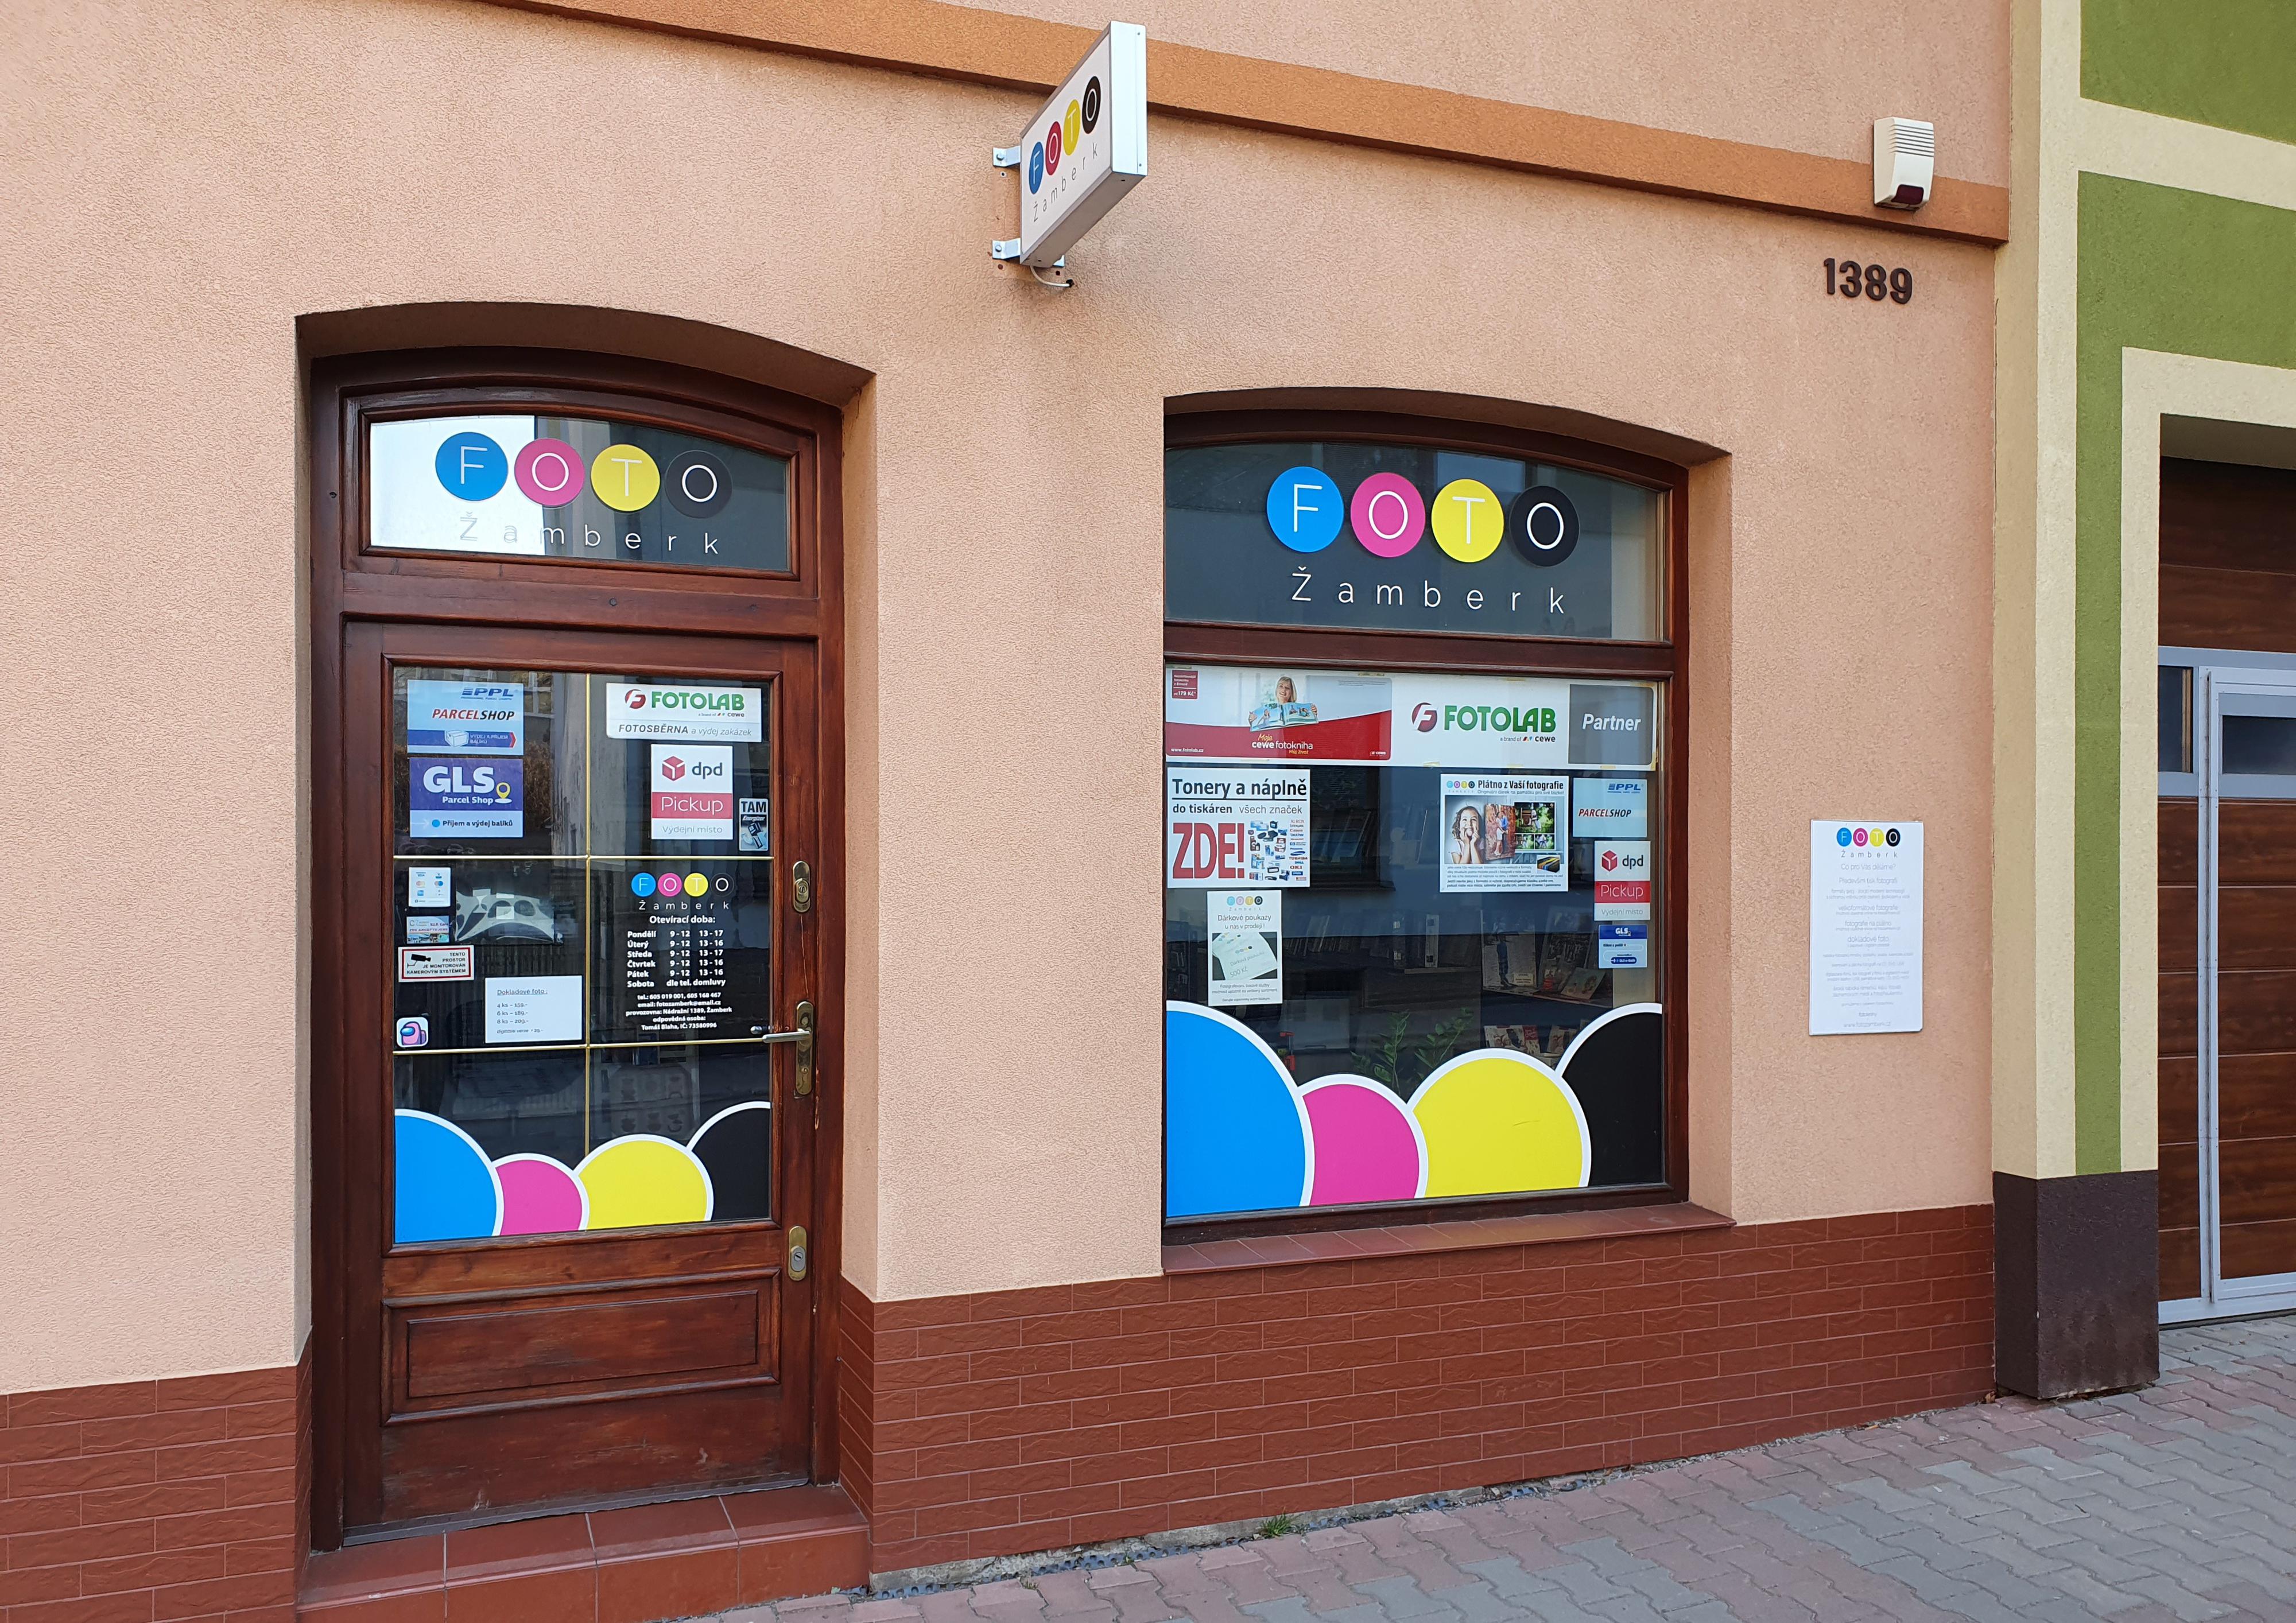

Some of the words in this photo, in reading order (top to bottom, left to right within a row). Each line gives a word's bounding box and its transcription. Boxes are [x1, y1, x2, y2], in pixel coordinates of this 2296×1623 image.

[1032, 87, 1098, 186] FOTO
[1033, 143, 1098, 223] Žamberk
[1824, 258, 1913, 305] 1389
[459, 444, 719, 504] FOTO
[1289, 480, 1568, 553] FOTO
[460, 511, 719, 555] Žamberk
[1292, 566, 1564, 614] Žamberk
[474, 688, 514, 697] PPL
[651, 690, 745, 710] FOTOLAB
[432, 708, 515, 721] PARCELSHOP
[1444, 705, 1556, 733] FOTOLAB
[1582, 713, 1641, 731] Partner
[619, 724, 689, 734] FOTOSBĚRNA
[697, 727, 719, 737] výdej
[720, 726, 752, 736] zakázek
[1275, 740, 1313, 750] fotokniha
[692, 762, 723, 779] dpd
[423, 766, 495, 794] GLS
[1477, 780, 1502, 789] Plátno
[1509, 780, 1525, 789] Vaší
[1526, 781, 1564, 791] fotografie
[1172, 778, 1231, 799] Tonery
[1236, 783, 1245, 795] a
[1251, 778, 1307, 799] náplně
[471, 796, 494, 806] Shop
[661, 796, 723, 816] Pickup
[740, 801, 767, 813] TAM
[1173, 803, 1186, 813] do
[1189, 803, 1232, 814] tiskáren
[1239, 805, 1267, 814] všech
[1269, 805, 1302, 814] značek
[1578, 808, 1631, 817] PARCELSHOP
[442, 820, 466, 828] Příjem
[471, 820, 490, 828] výdej
[662, 825, 695, 834] Výdejní
[697, 825, 723, 833] místo
[1840, 830, 1898, 844] FOTO
[1172, 822, 1245, 879] ZDE!
[1841, 849, 1898, 858] Žamberk
[1622, 855, 1643, 870] dpd
[637, 876, 731, 894] FOTO
[1600, 884, 1643, 899] Pickup
[638, 899, 729, 911] Žamberk
[649, 915, 689, 923] Otevírací
[691, 915, 716, 923] doba:
[1244, 914, 1271, 922] poukazy
[627, 939, 649, 949] Úterý
[627, 950, 653, 958] Středa
[627, 960, 656, 968] Čtvrtek
[627, 970, 649, 978] Pátek
[627, 980, 655, 988] Sobota
[692, 979, 726, 987] domluvy
